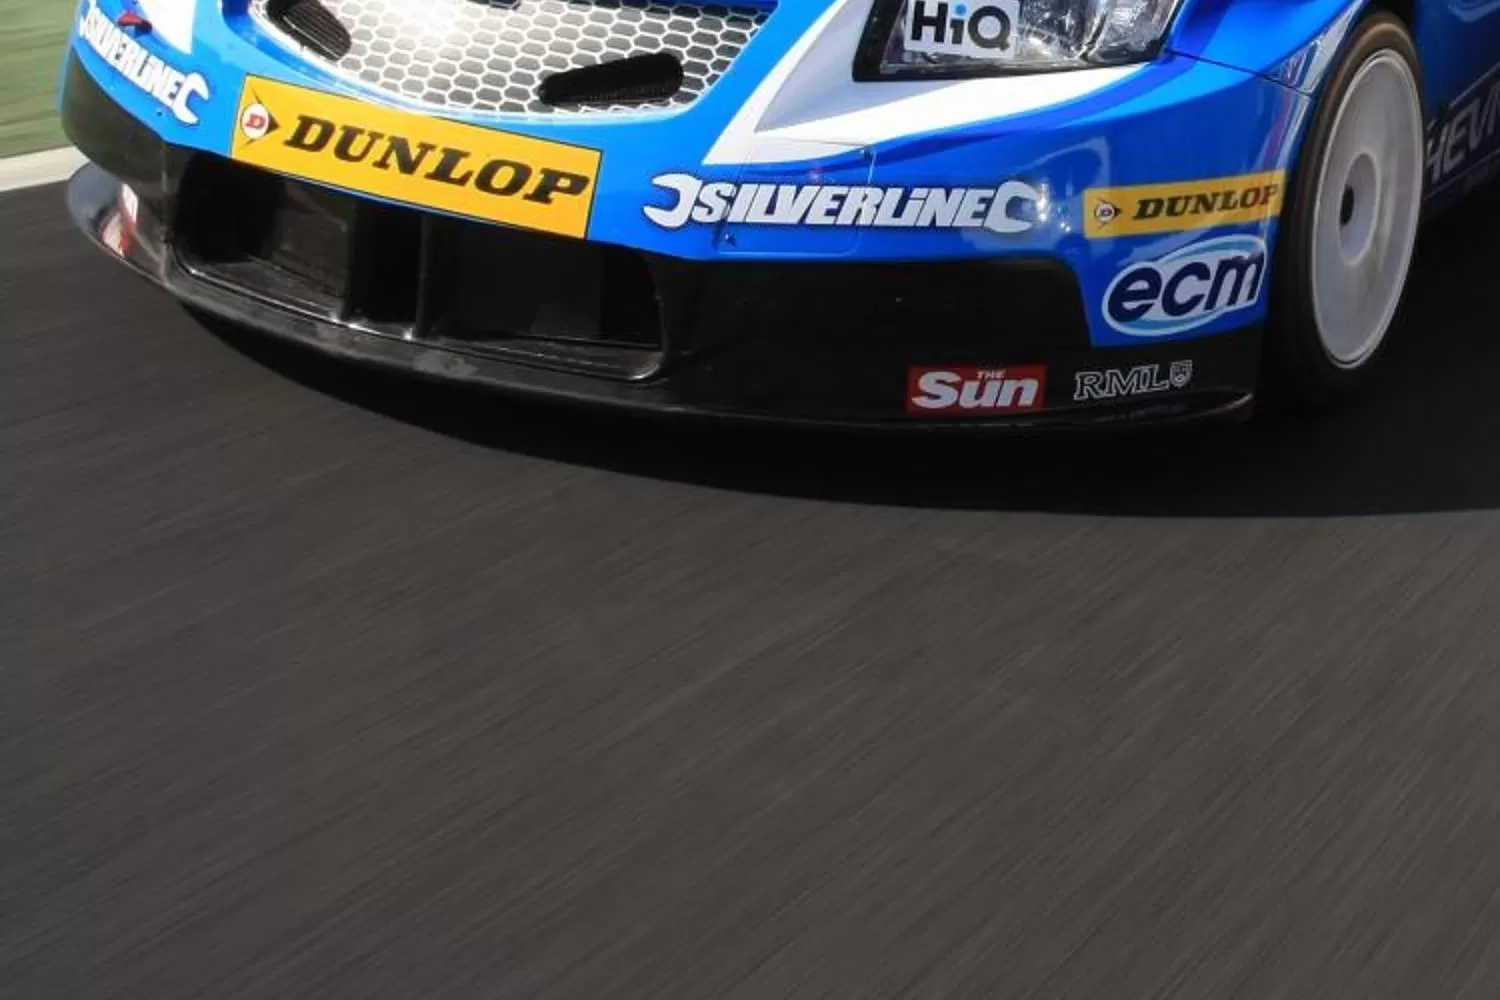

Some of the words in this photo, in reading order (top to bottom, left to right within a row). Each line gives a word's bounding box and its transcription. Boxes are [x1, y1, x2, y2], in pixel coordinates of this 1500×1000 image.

[909, 0, 1012, 51] HiQ
[283, 113, 591, 207] DUNLOP
[1131, 182, 1281, 222] DUNLOP
[1106, 251, 1265, 325] ecm
[911, 371, 1040, 409] Sun
[1073, 363, 1170, 401] RML
